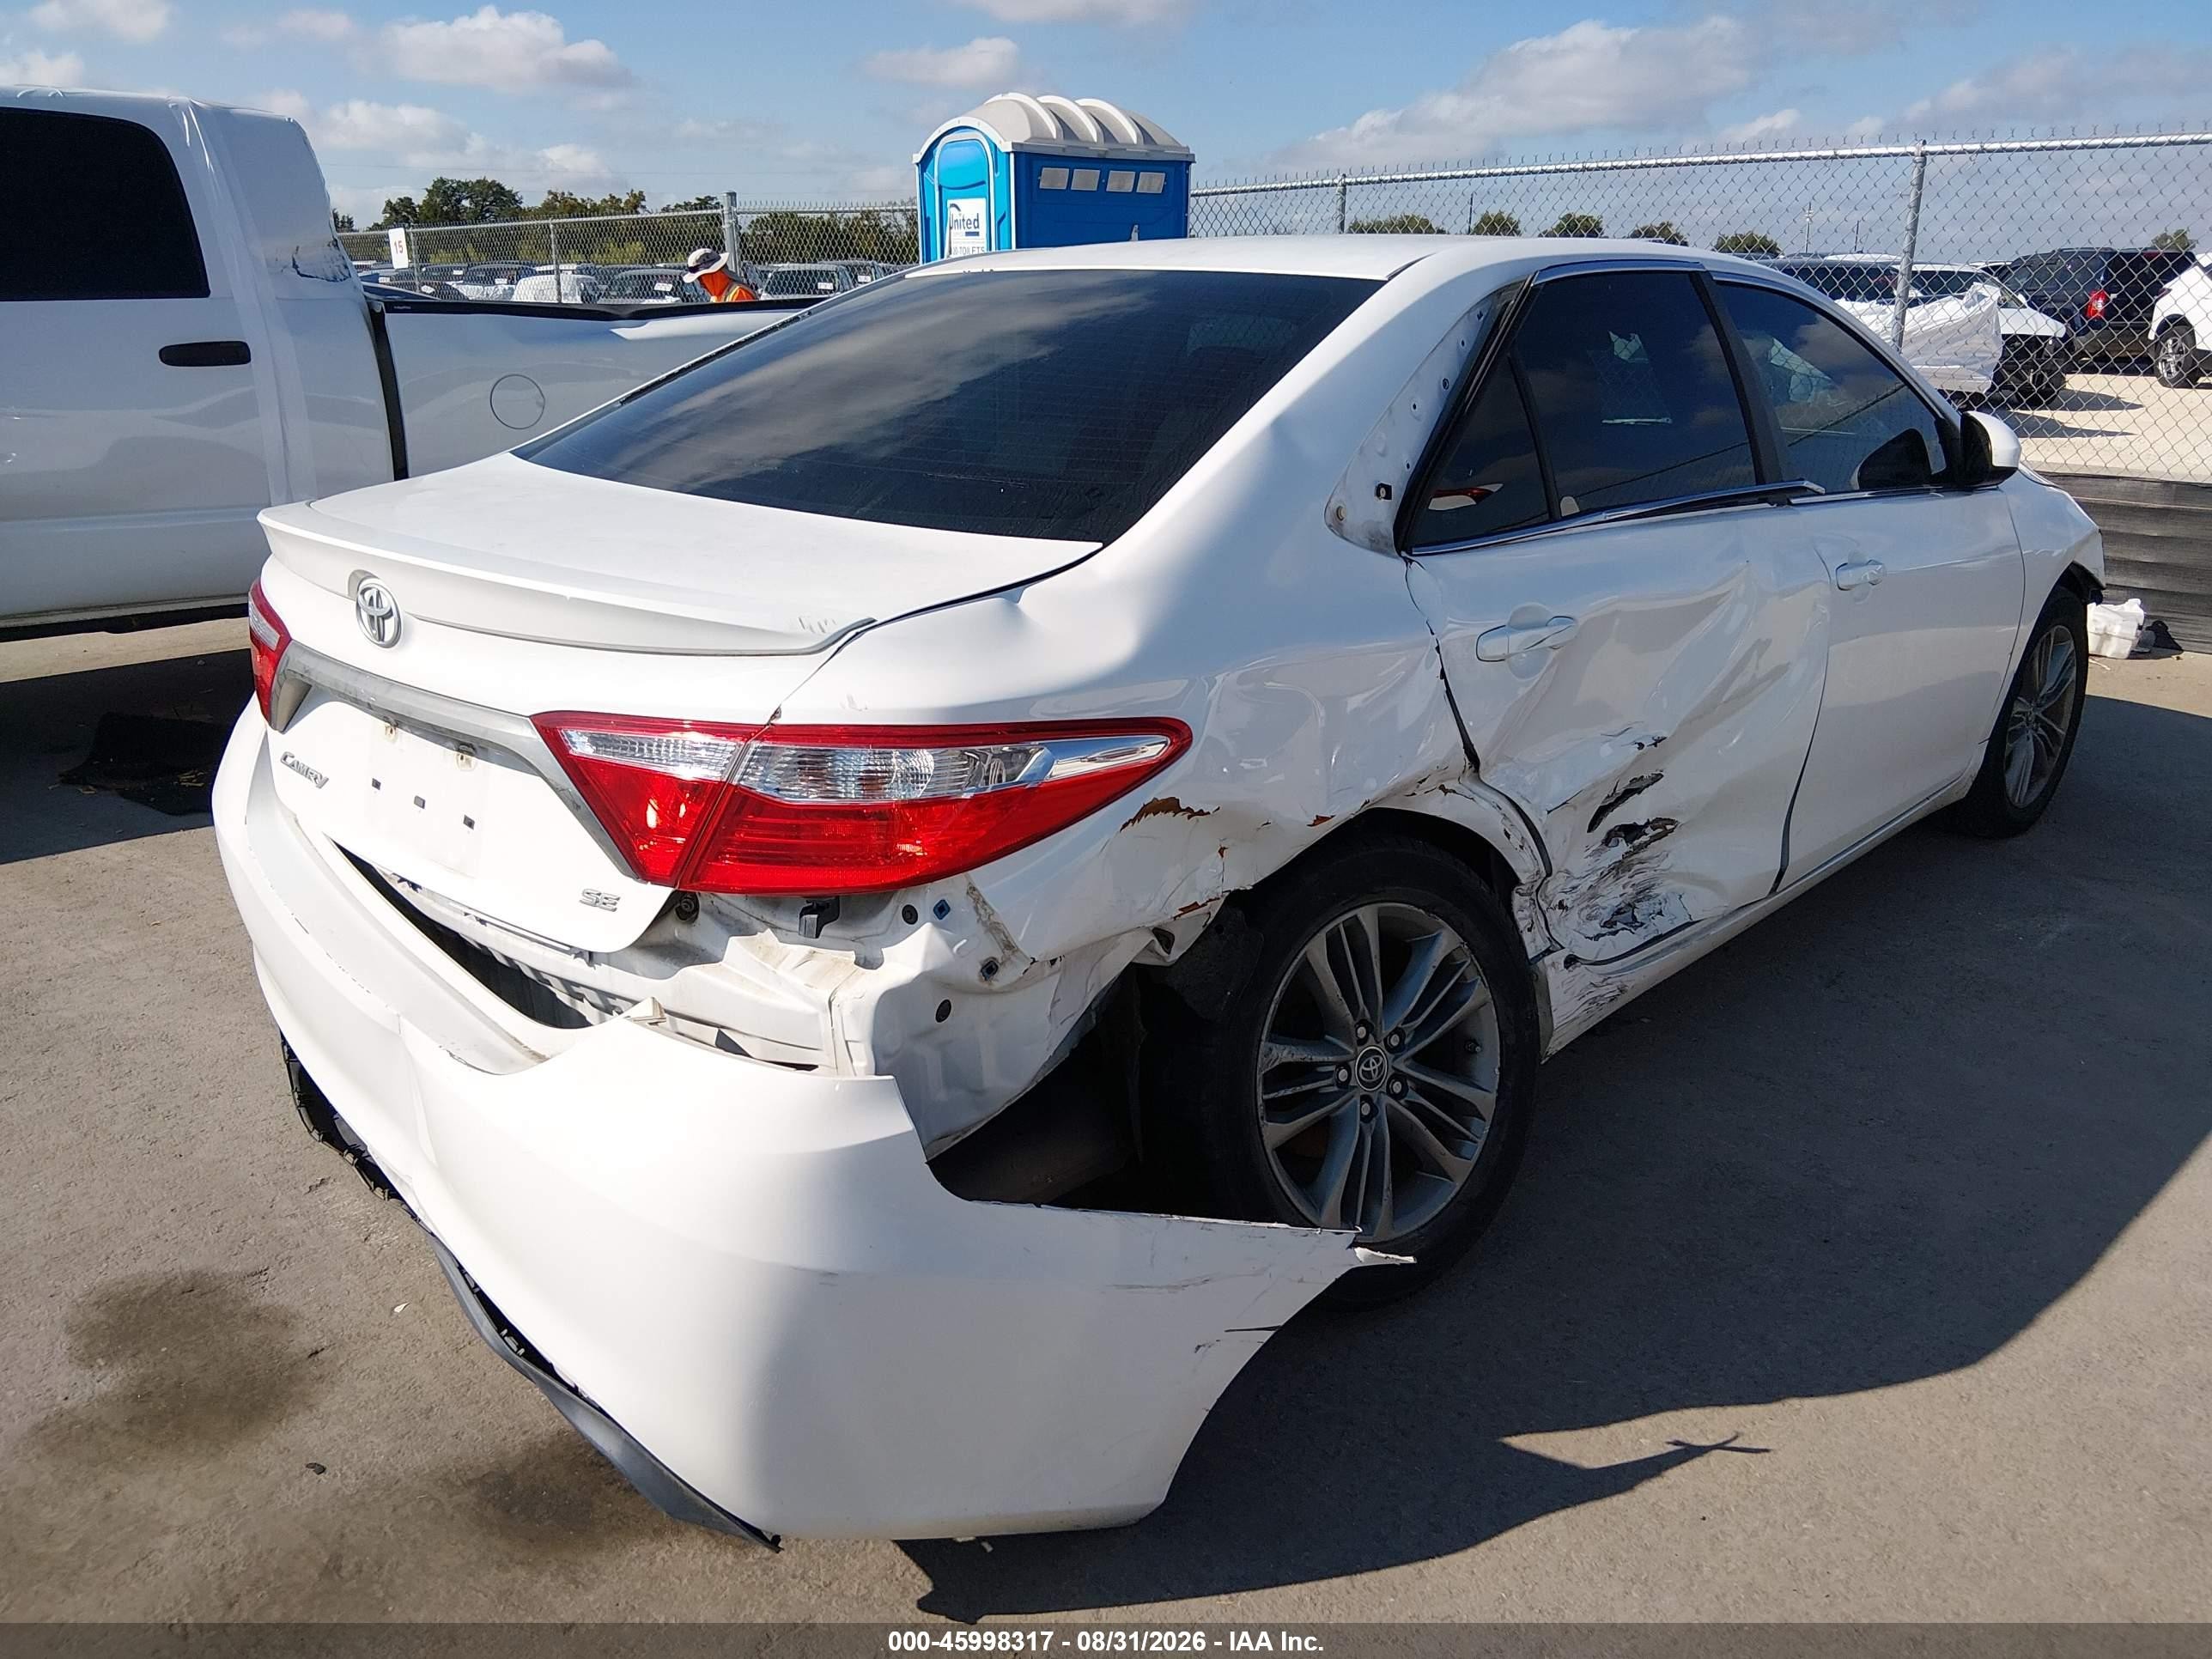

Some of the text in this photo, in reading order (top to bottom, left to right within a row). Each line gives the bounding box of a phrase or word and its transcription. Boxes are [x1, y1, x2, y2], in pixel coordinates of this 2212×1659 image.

[393, 240, 404, 255] 15
[280, 750, 330, 789] CAMRY
[578, 888, 621, 912] SE
